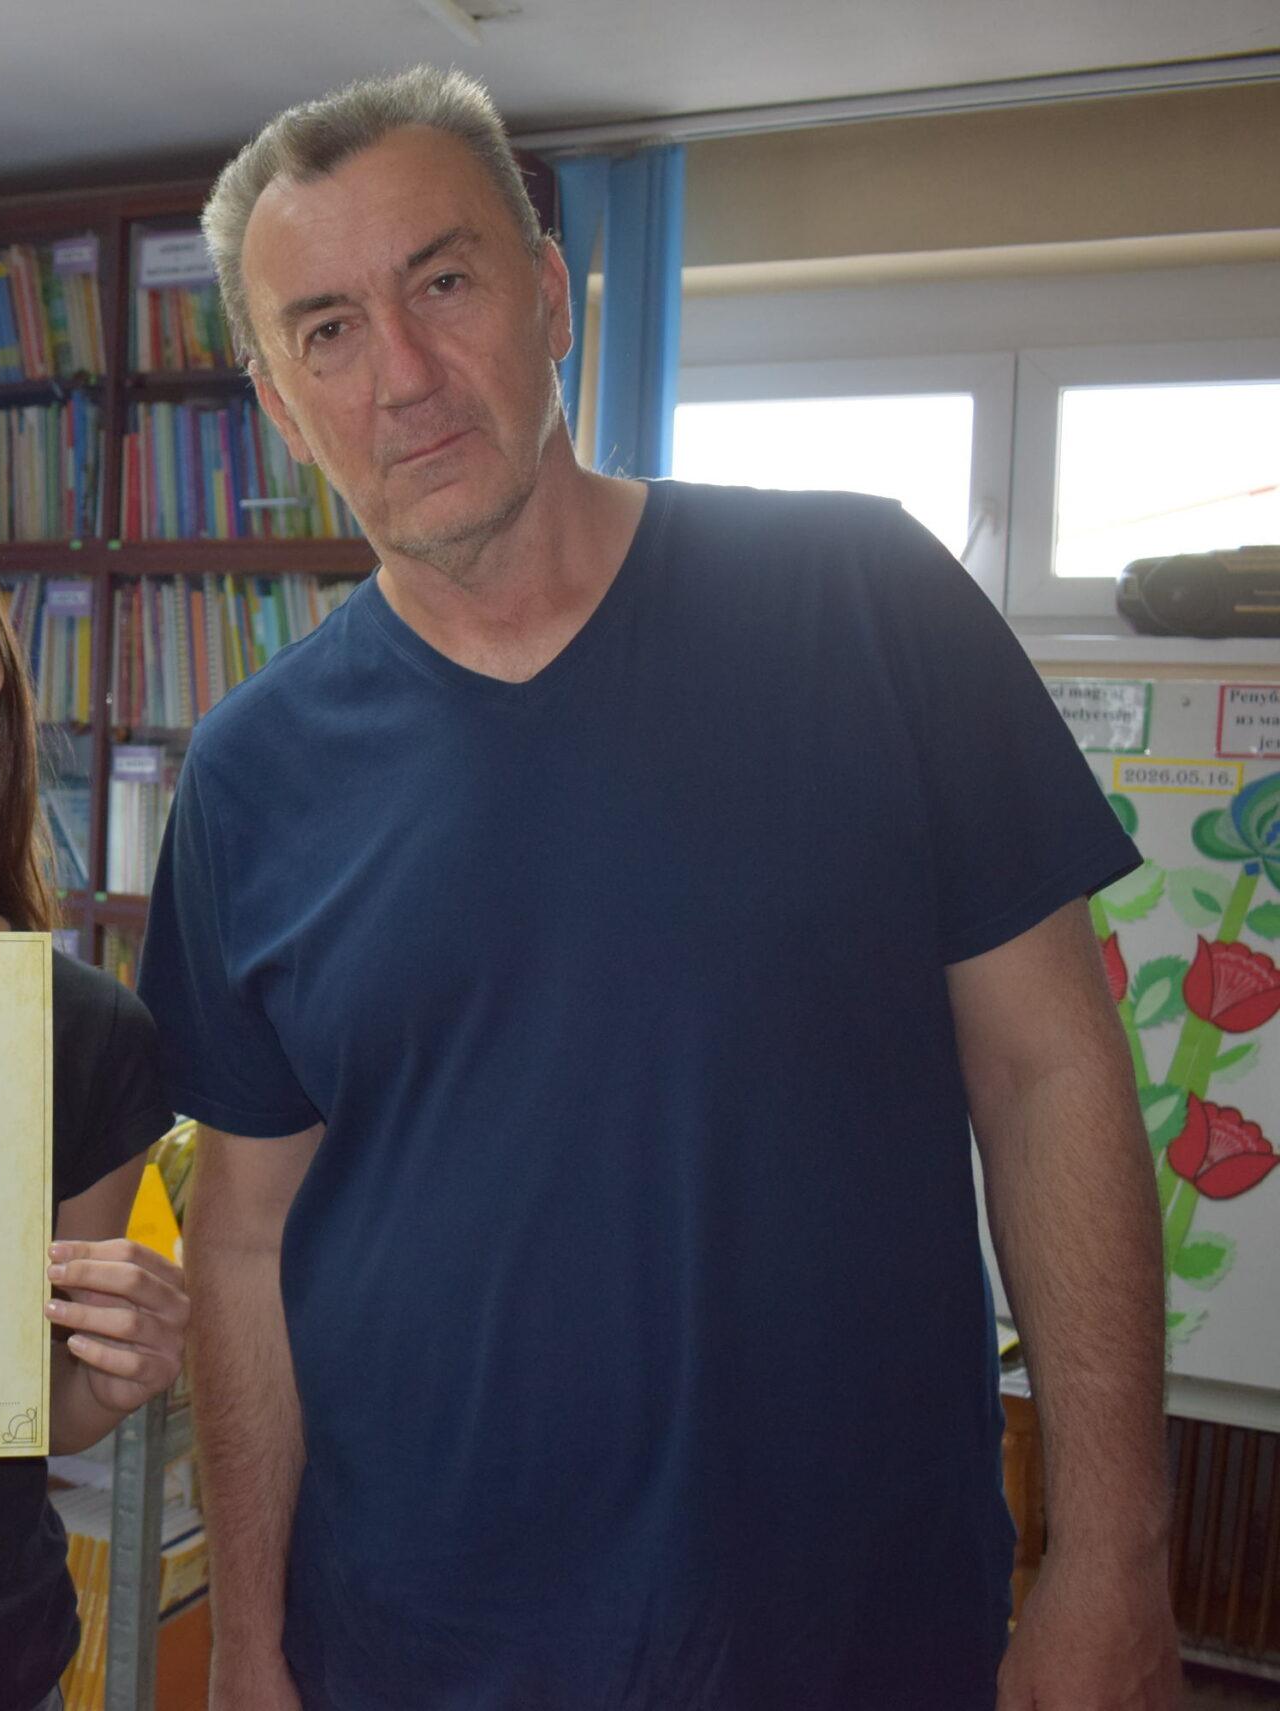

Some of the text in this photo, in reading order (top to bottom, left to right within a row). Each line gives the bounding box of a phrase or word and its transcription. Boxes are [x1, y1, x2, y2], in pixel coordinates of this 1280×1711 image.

[1229, 688, 1280, 707] Репуб
[1259, 715, 1280, 727] ма
[1123, 768, 1234, 786] 2026.05.16.
